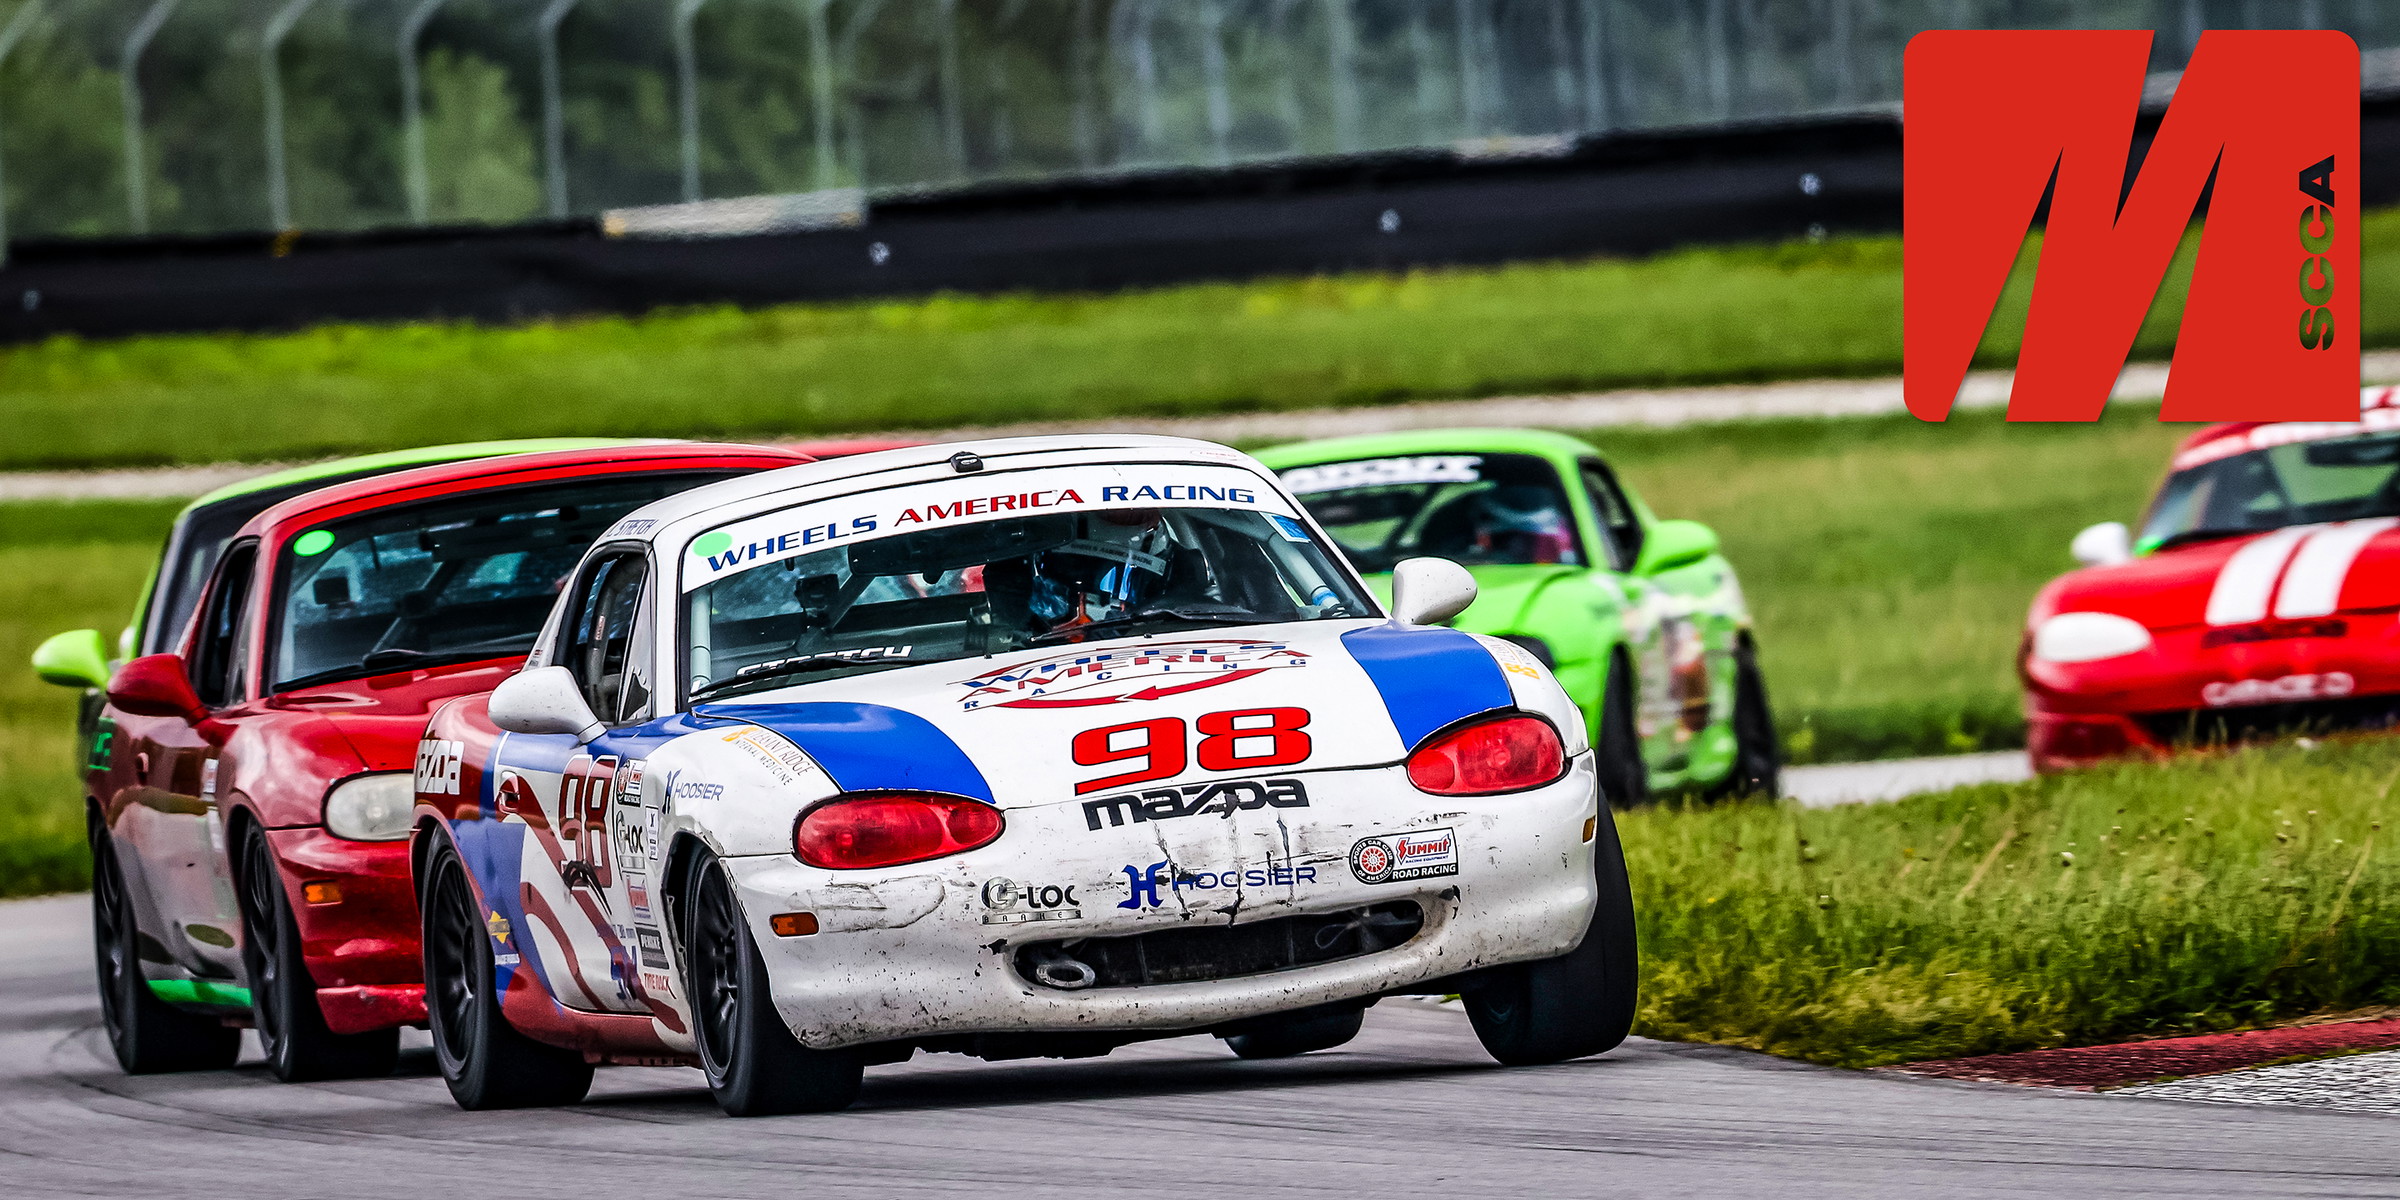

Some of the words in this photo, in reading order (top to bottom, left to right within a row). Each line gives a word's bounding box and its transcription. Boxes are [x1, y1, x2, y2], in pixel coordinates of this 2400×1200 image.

[707, 514, 878, 572] WHEELS
[894, 489, 1085, 528] AMERICA
[1102, 485, 1255, 504] RACING
[957, 650, 1312, 702] AMERICA
[962, 645, 1286, 688] WHEELS
[964, 658, 1307, 710] RACING
[779, 745, 815, 777] RIDGE
[1071, 706, 1312, 796] 98
[759, 756, 794, 787] MEDICINE
[674, 782, 724, 801] HOOSIER
[559, 754, 618, 888] 98
[1353, 842, 1367, 865] SPORTS
[1368, 839, 1382, 847] CAR
[1382, 843, 1394, 861] CLUB
[1172, 866, 1318, 892] HOOSIER
[1357, 869, 1366, 878] OF
[1392, 867, 1419, 880] ROAD
[1420, 863, 1456, 876] RACING
[980, 876, 1080, 910] G-LOC
[982, 910, 1082, 924] BRAKES
